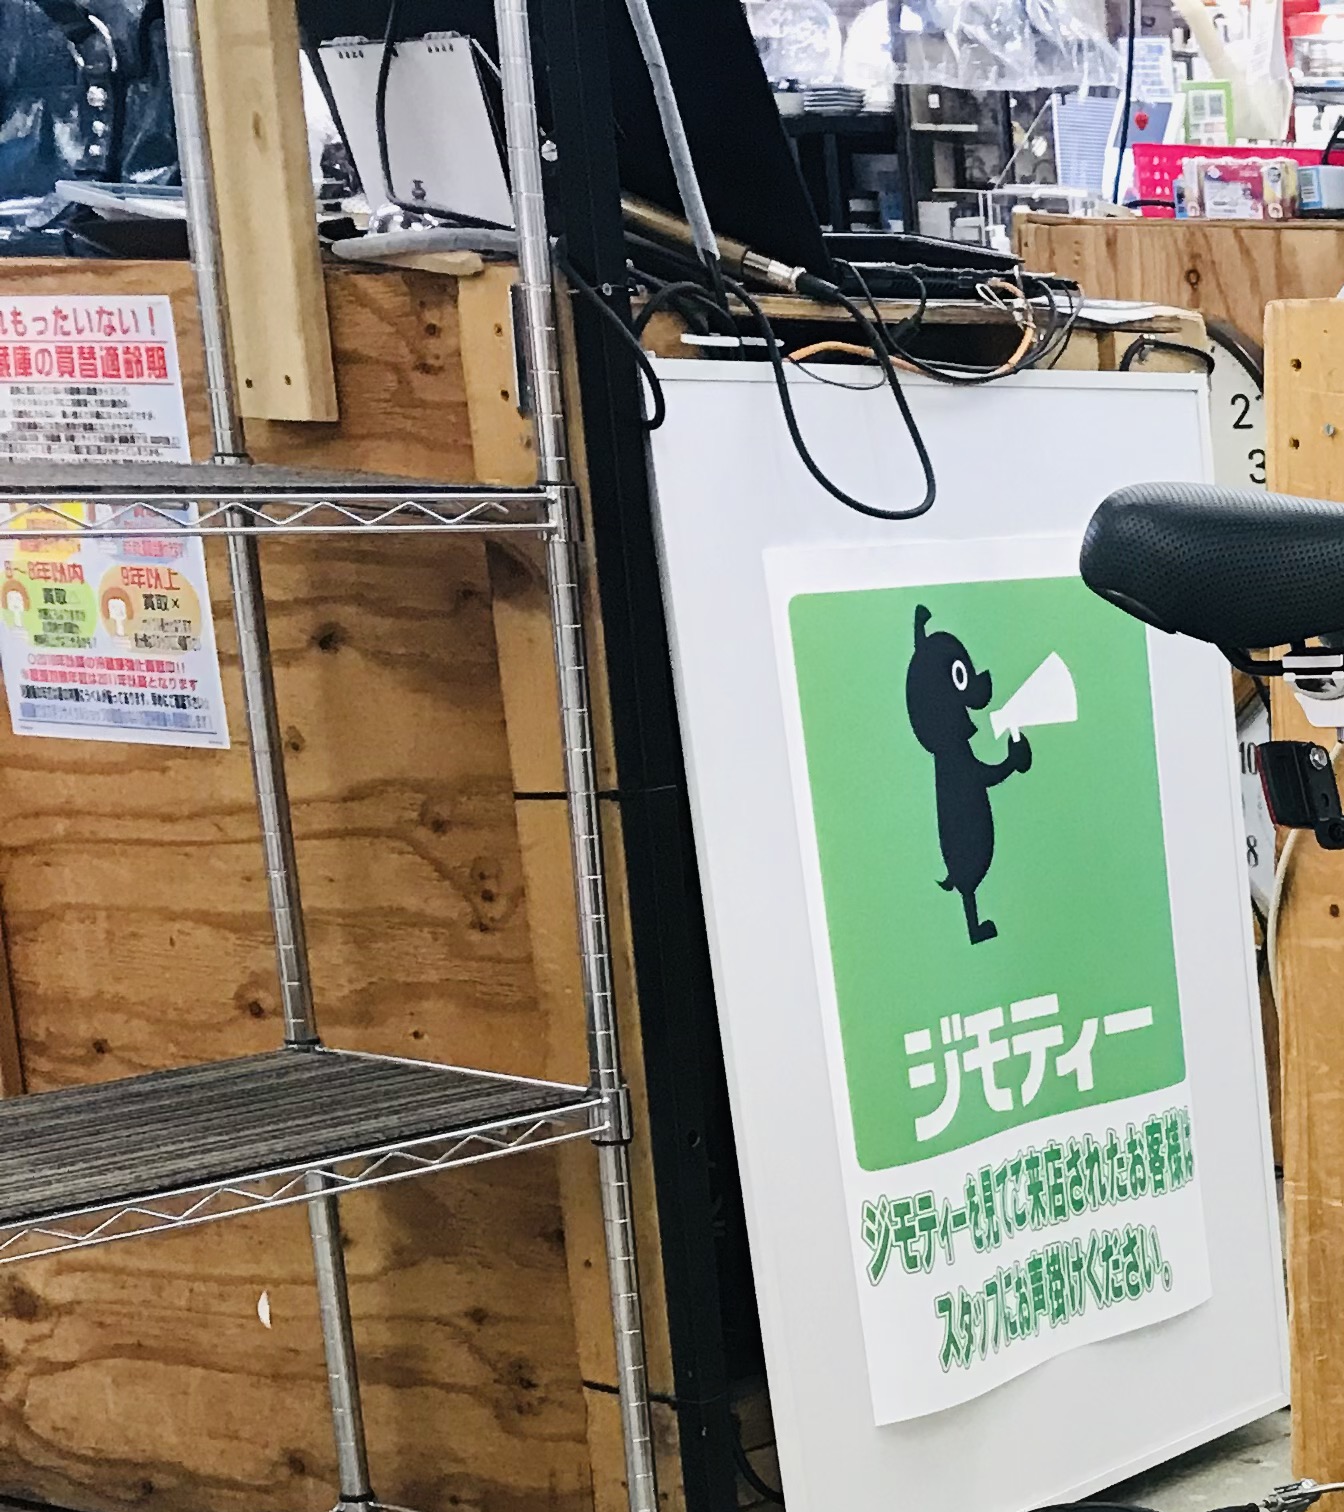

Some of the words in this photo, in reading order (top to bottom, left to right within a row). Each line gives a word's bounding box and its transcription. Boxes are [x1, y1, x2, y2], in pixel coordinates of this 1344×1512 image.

[1231, 393, 1254, 430] 2
[1248, 448, 1267, 485] 3
[1246, 834, 1259, 868] 8
[903, 993, 1153, 1142] ジモティー
